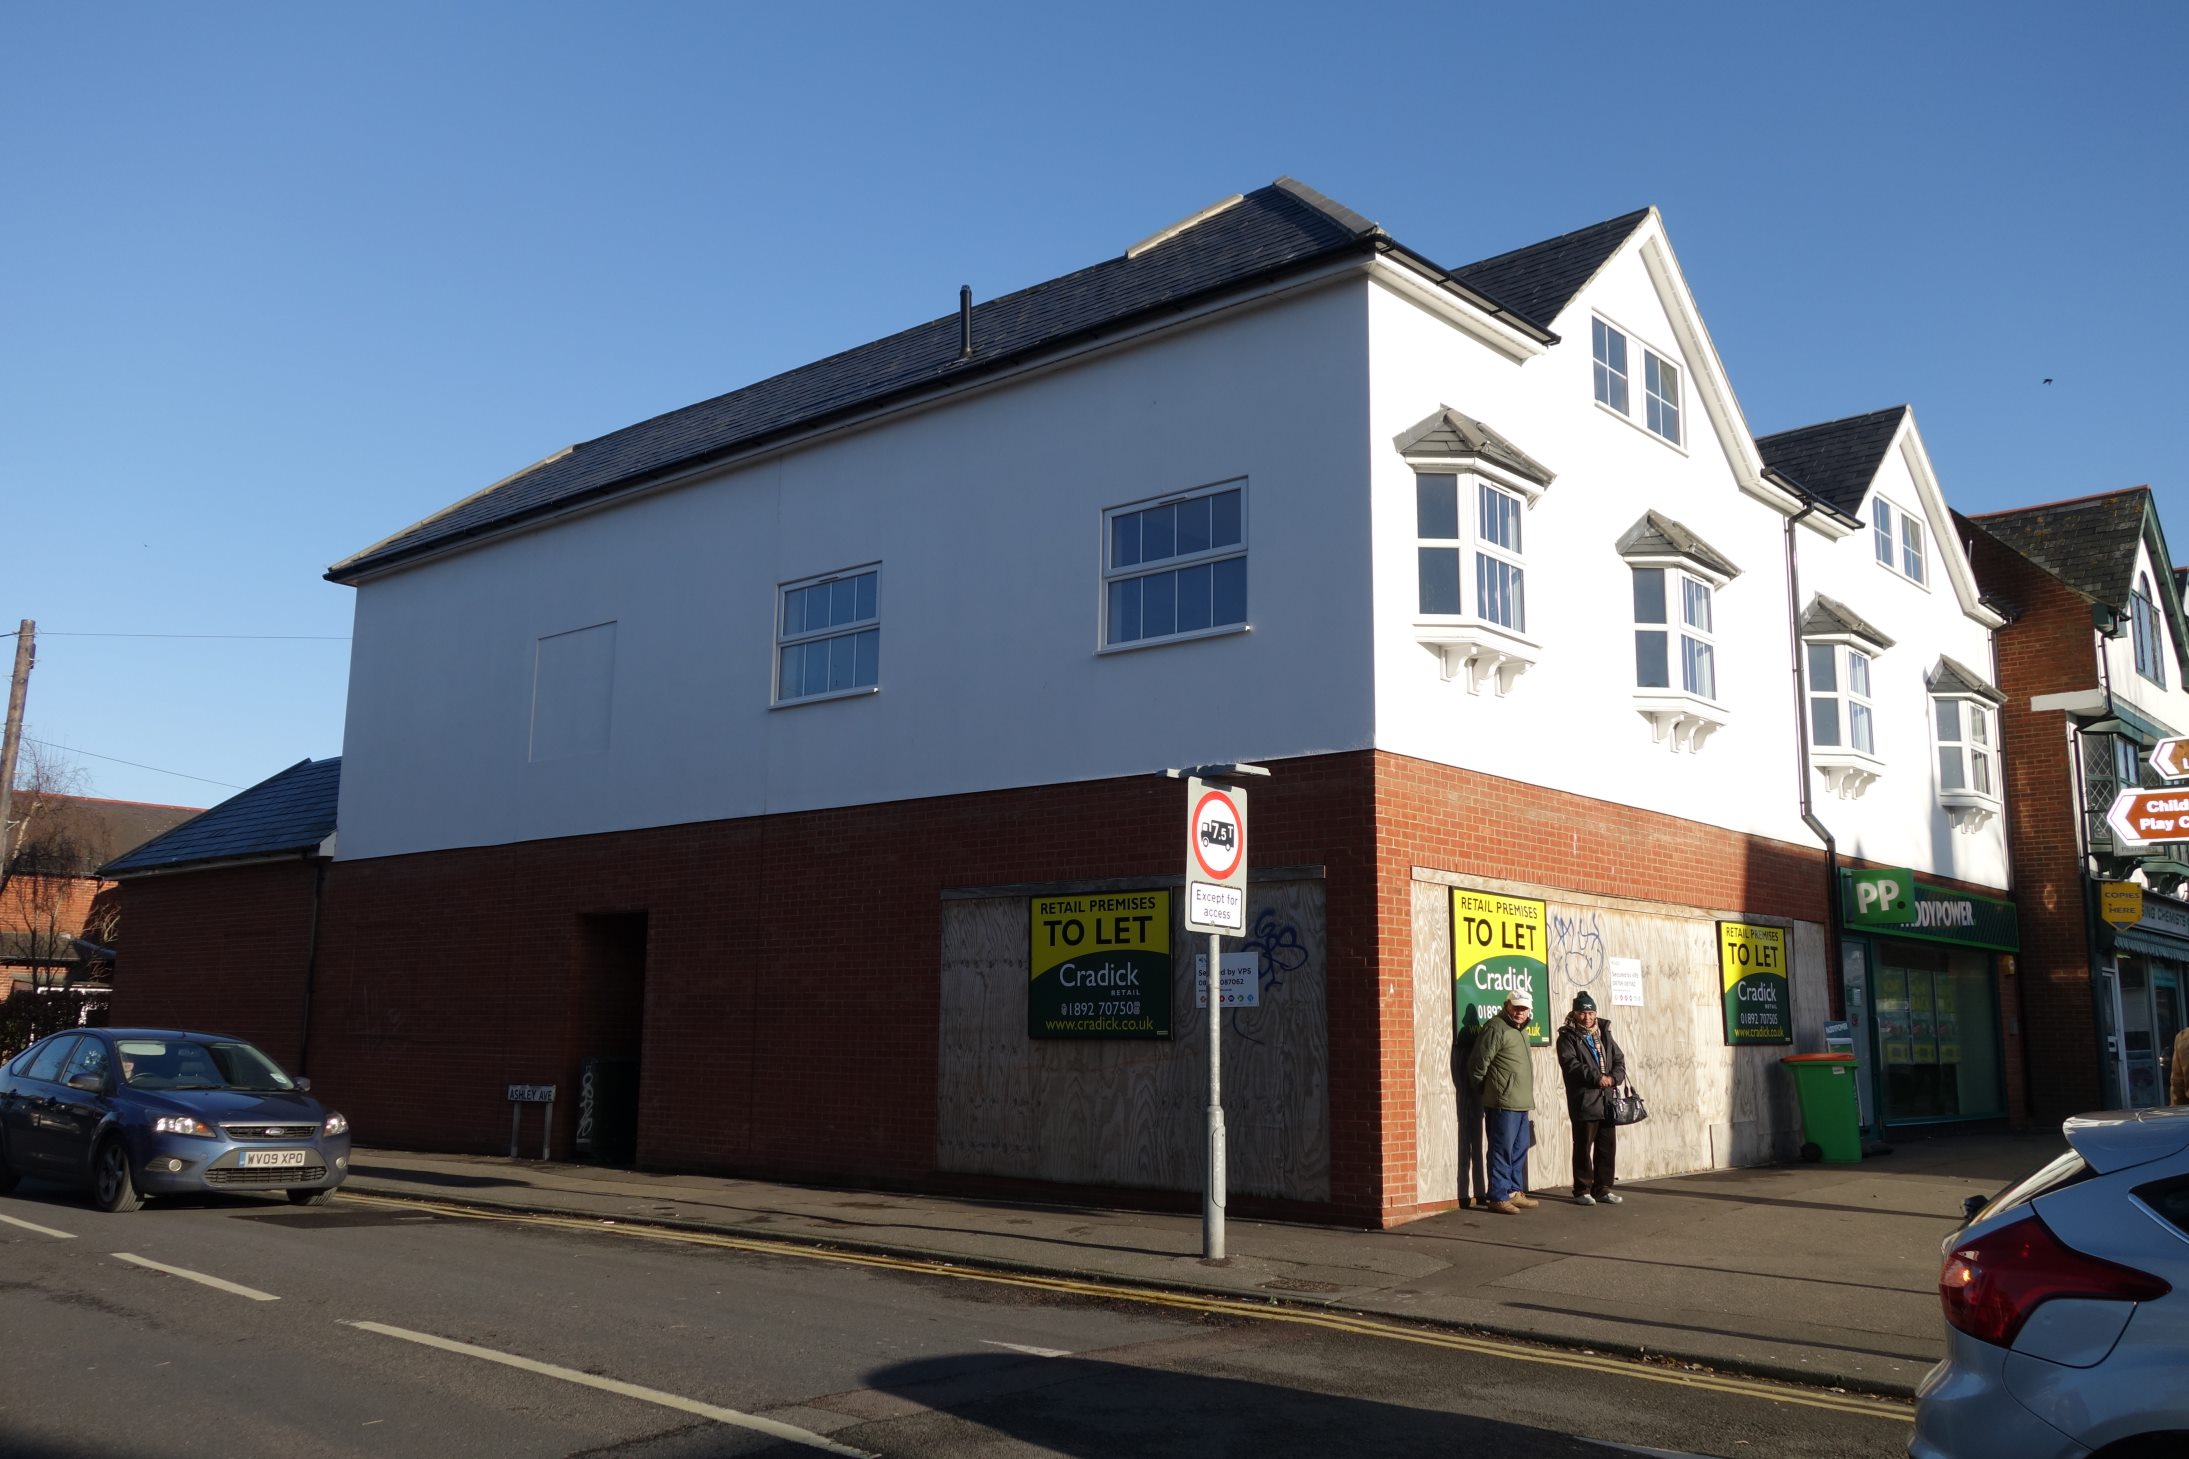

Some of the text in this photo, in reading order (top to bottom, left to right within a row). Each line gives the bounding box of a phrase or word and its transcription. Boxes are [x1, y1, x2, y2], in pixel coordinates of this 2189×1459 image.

[2140, 818, 2175, 831] Play
[1196, 889, 1238, 906] Except for
[1040, 897, 1156, 915] RETAIL PREMISES
[1203, 907, 1231, 920] access
[1461, 897, 1538, 919] RETAIL PREMISES
[1043, 915, 1153, 947] TO LET
[1463, 917, 1537, 951] TO LET
[1726, 926, 1779, 942] RETAIL PREMISES
[1728, 943, 1779, 968] TO LET
[1059, 962, 1140, 987] Cradick
[1227, 969, 1236, 977] by
[1237, 967, 1252, 976] VPS
[1474, 964, 1533, 992] Cradick
[1737, 981, 1777, 1002] Cradick
[1045, 1016, 1154, 1031] www.cradick.co.uk
[1740, 1012, 1778, 1025] 01892 707505
[1734, 1025, 1785, 1038] www.cradick.co.uk
[509, 1089, 553, 1100] ASHLEY AVE
[248, 1153, 279, 1165] WV09
